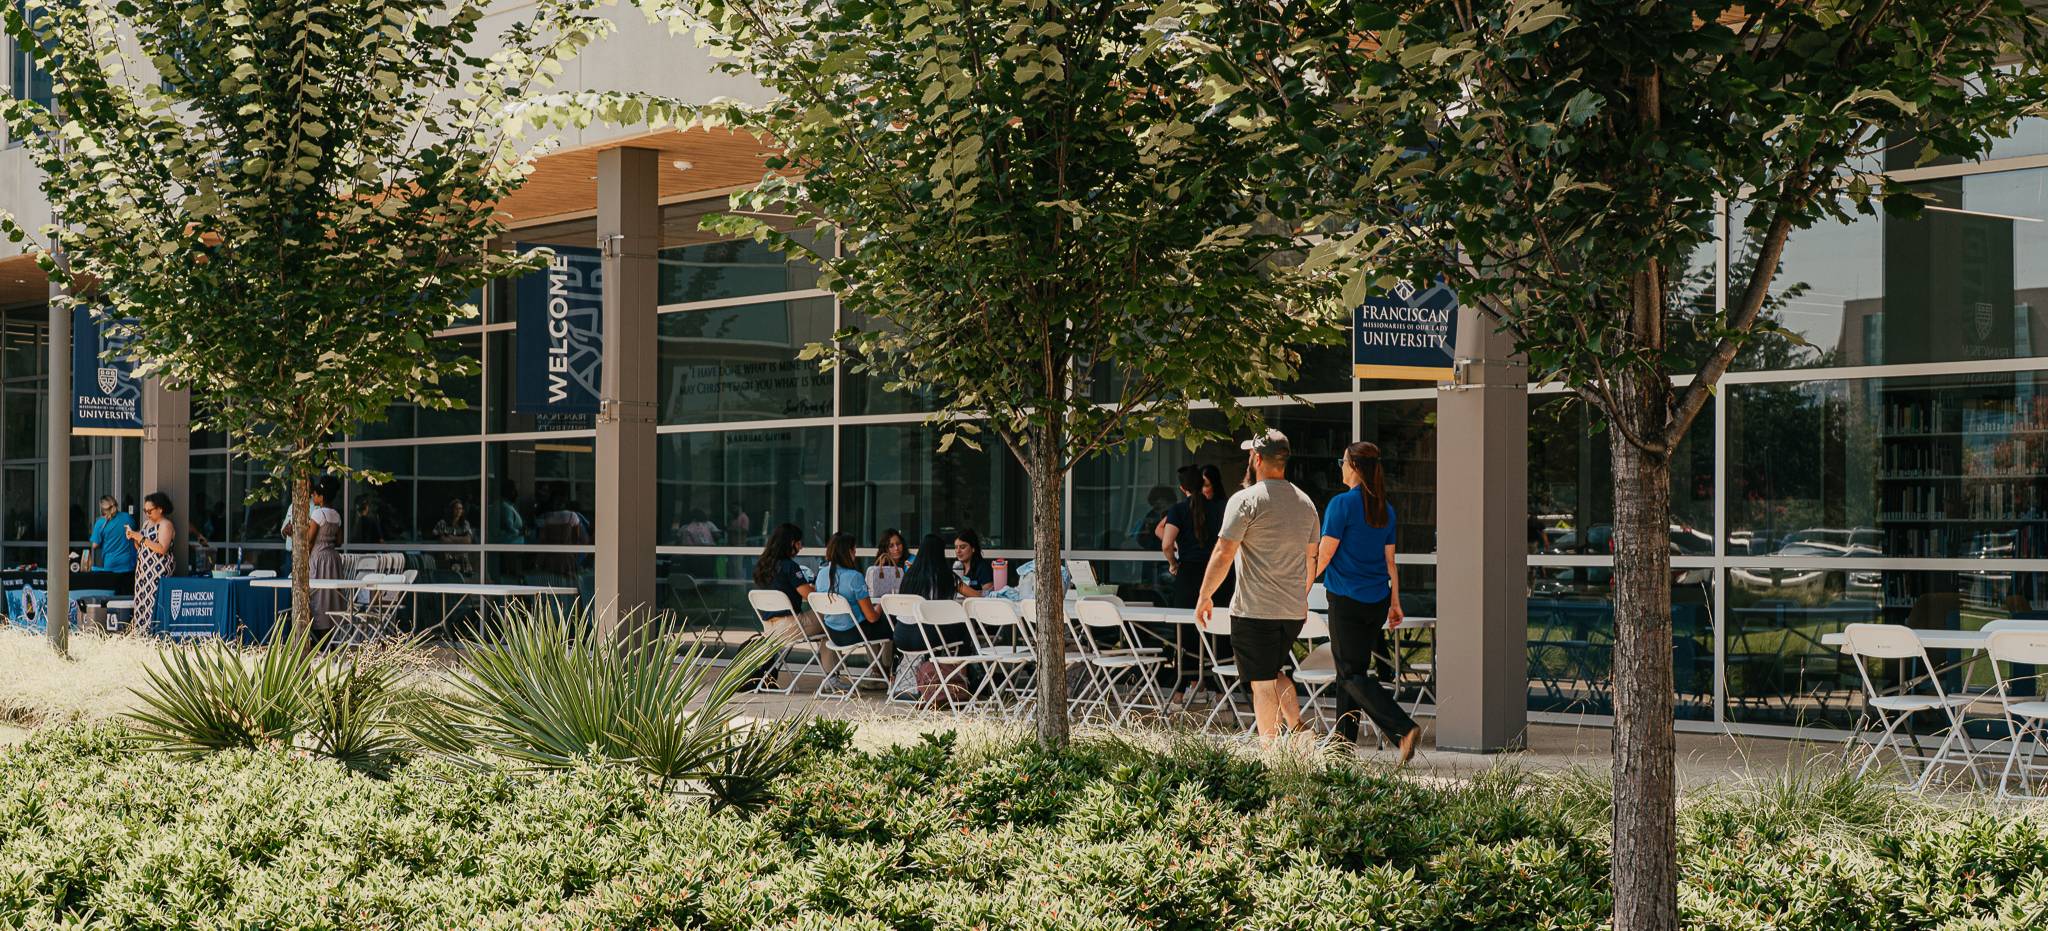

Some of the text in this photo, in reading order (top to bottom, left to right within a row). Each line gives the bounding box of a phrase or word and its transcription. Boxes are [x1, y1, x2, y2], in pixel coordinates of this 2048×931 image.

[1362, 305, 1449, 323] FRANCISCAN
[549, 254, 569, 404] WELCOME
[1363, 322, 1405, 330] MISSIONARIES
[1363, 331, 1447, 349] UNIVERSITY
[744, 363, 767, 374] WHAT
[79, 395, 135, 407] FRANCISCAN
[79, 410, 136, 420] UNIVERSITY
[183, 591, 215, 601] FRANCISCAN
[181, 607, 214, 617] UNIVERSITY
